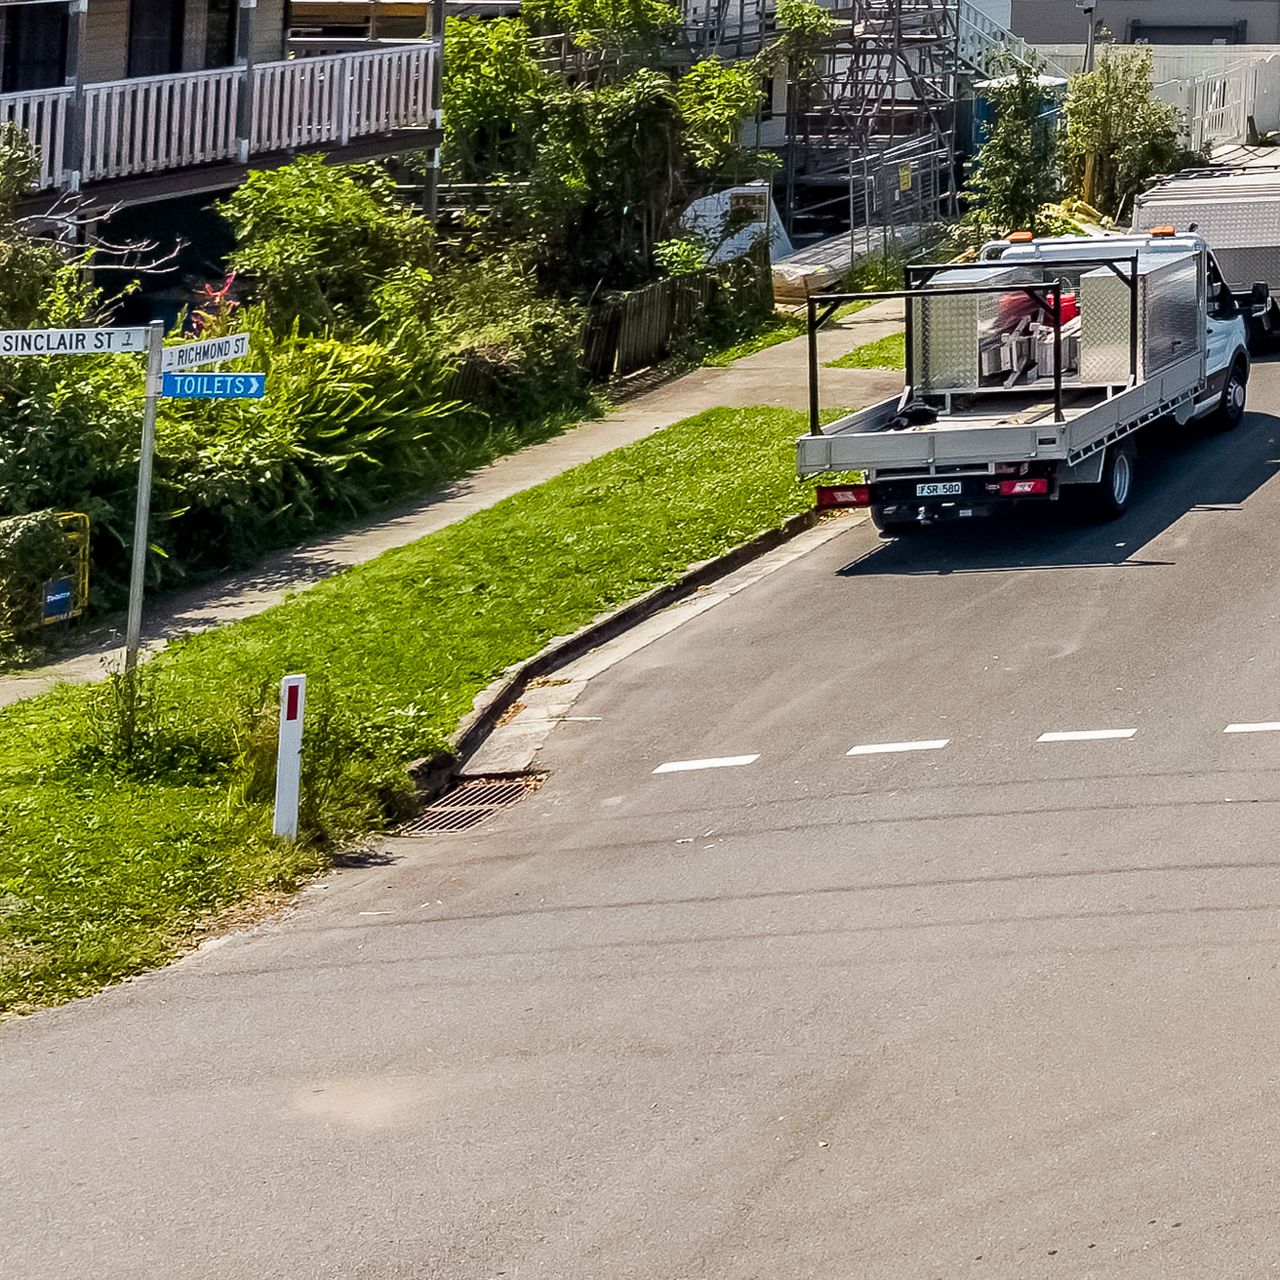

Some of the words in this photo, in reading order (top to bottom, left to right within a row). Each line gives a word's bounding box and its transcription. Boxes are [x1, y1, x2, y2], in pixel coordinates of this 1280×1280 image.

[2, 333, 86, 352] SINCLAIR
[93, 332, 115, 349] ST
[177, 340, 232, 366] RICHMOND
[233, 337, 246, 354] ST
[176, 376, 245, 394] TOILETS
